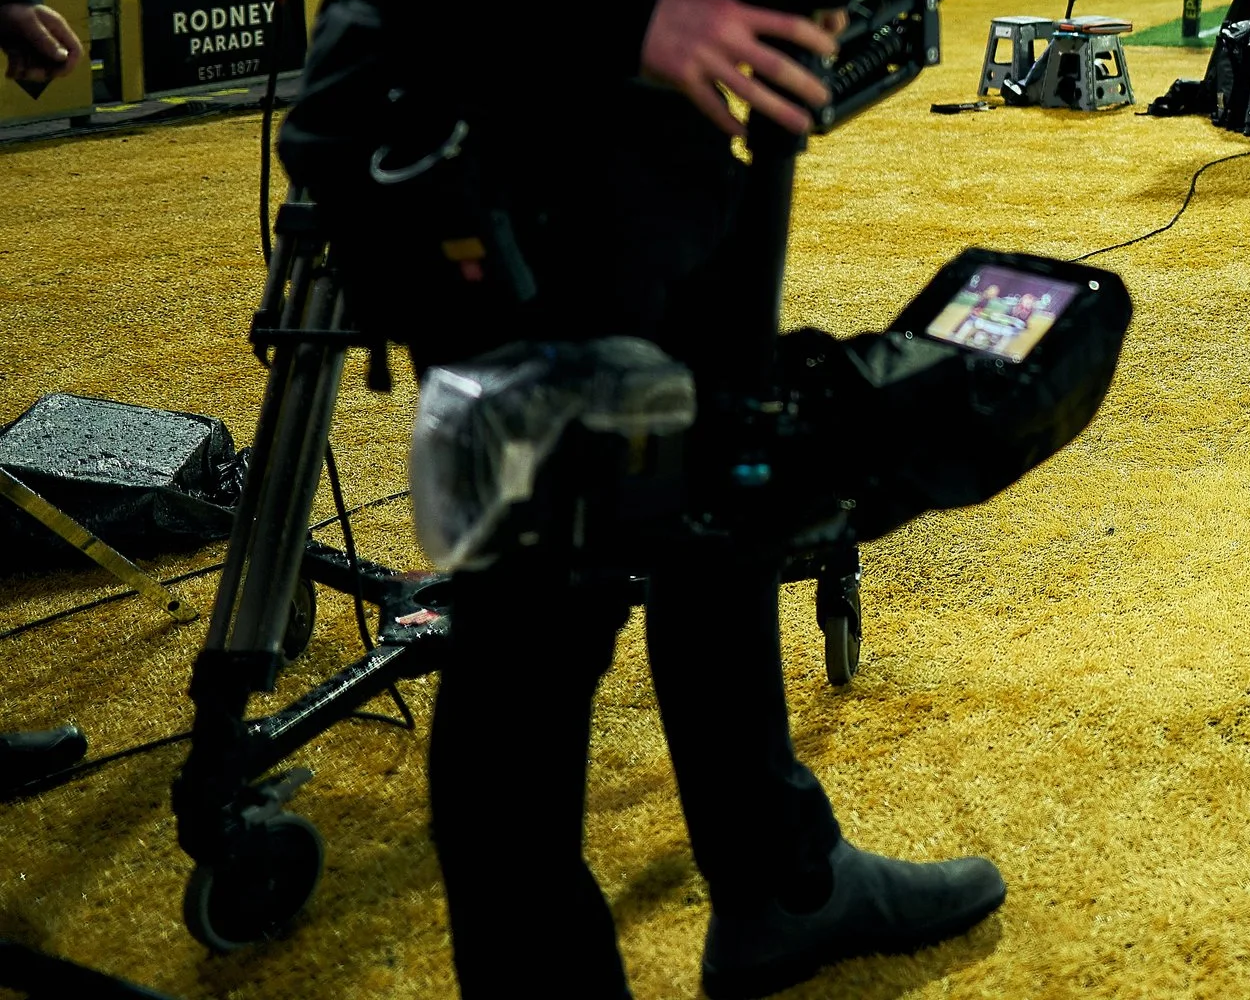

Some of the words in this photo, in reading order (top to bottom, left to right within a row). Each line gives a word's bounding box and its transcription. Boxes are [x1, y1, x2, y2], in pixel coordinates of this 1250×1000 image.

[172, 1, 276, 35] RODNEY
[190, 28, 265, 55] PARADE
[230, 58, 261, 76] 1877
